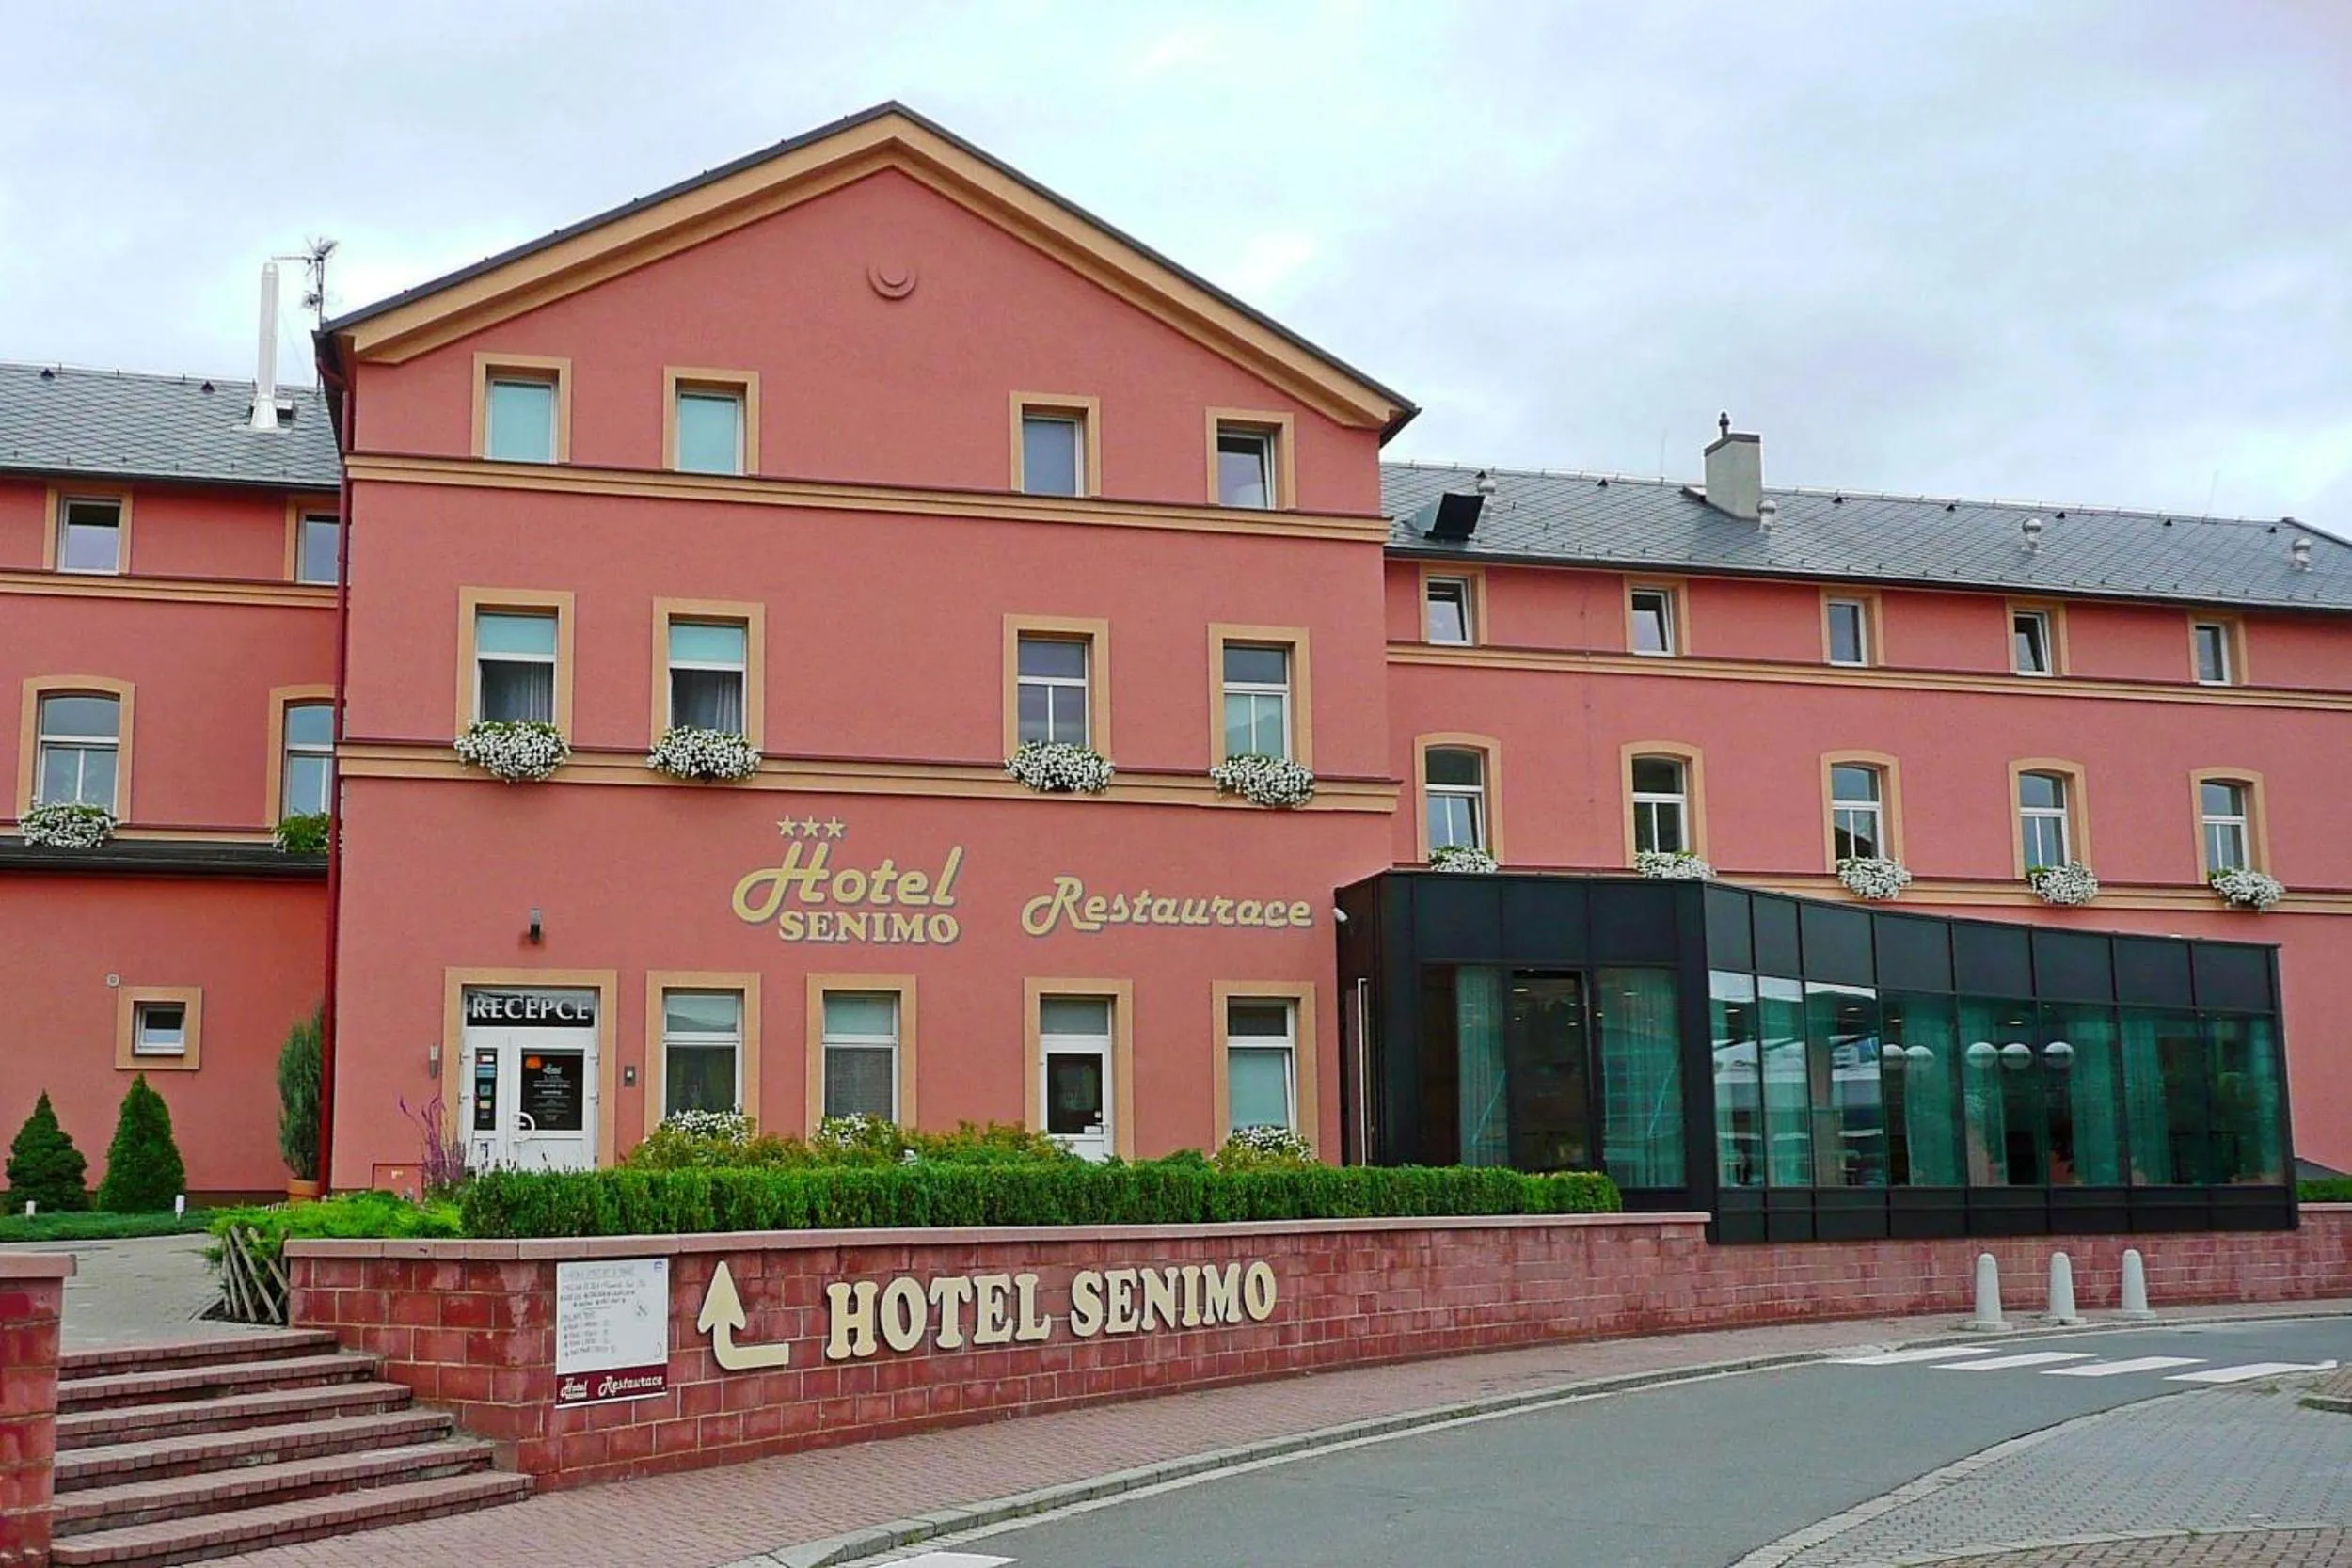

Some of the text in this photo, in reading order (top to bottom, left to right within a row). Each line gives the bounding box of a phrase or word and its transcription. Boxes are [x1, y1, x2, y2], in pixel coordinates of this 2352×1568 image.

[731, 841, 964, 924] Hotel
[778, 909, 961, 945] SENIMO
[1021, 877, 1313, 937] Restaurace
[472, 997, 590, 1020] RECEPCE
[826, 1261, 1279, 1360] HOTEL SENIMO
[598, 1375, 663, 1398] Restaurace
